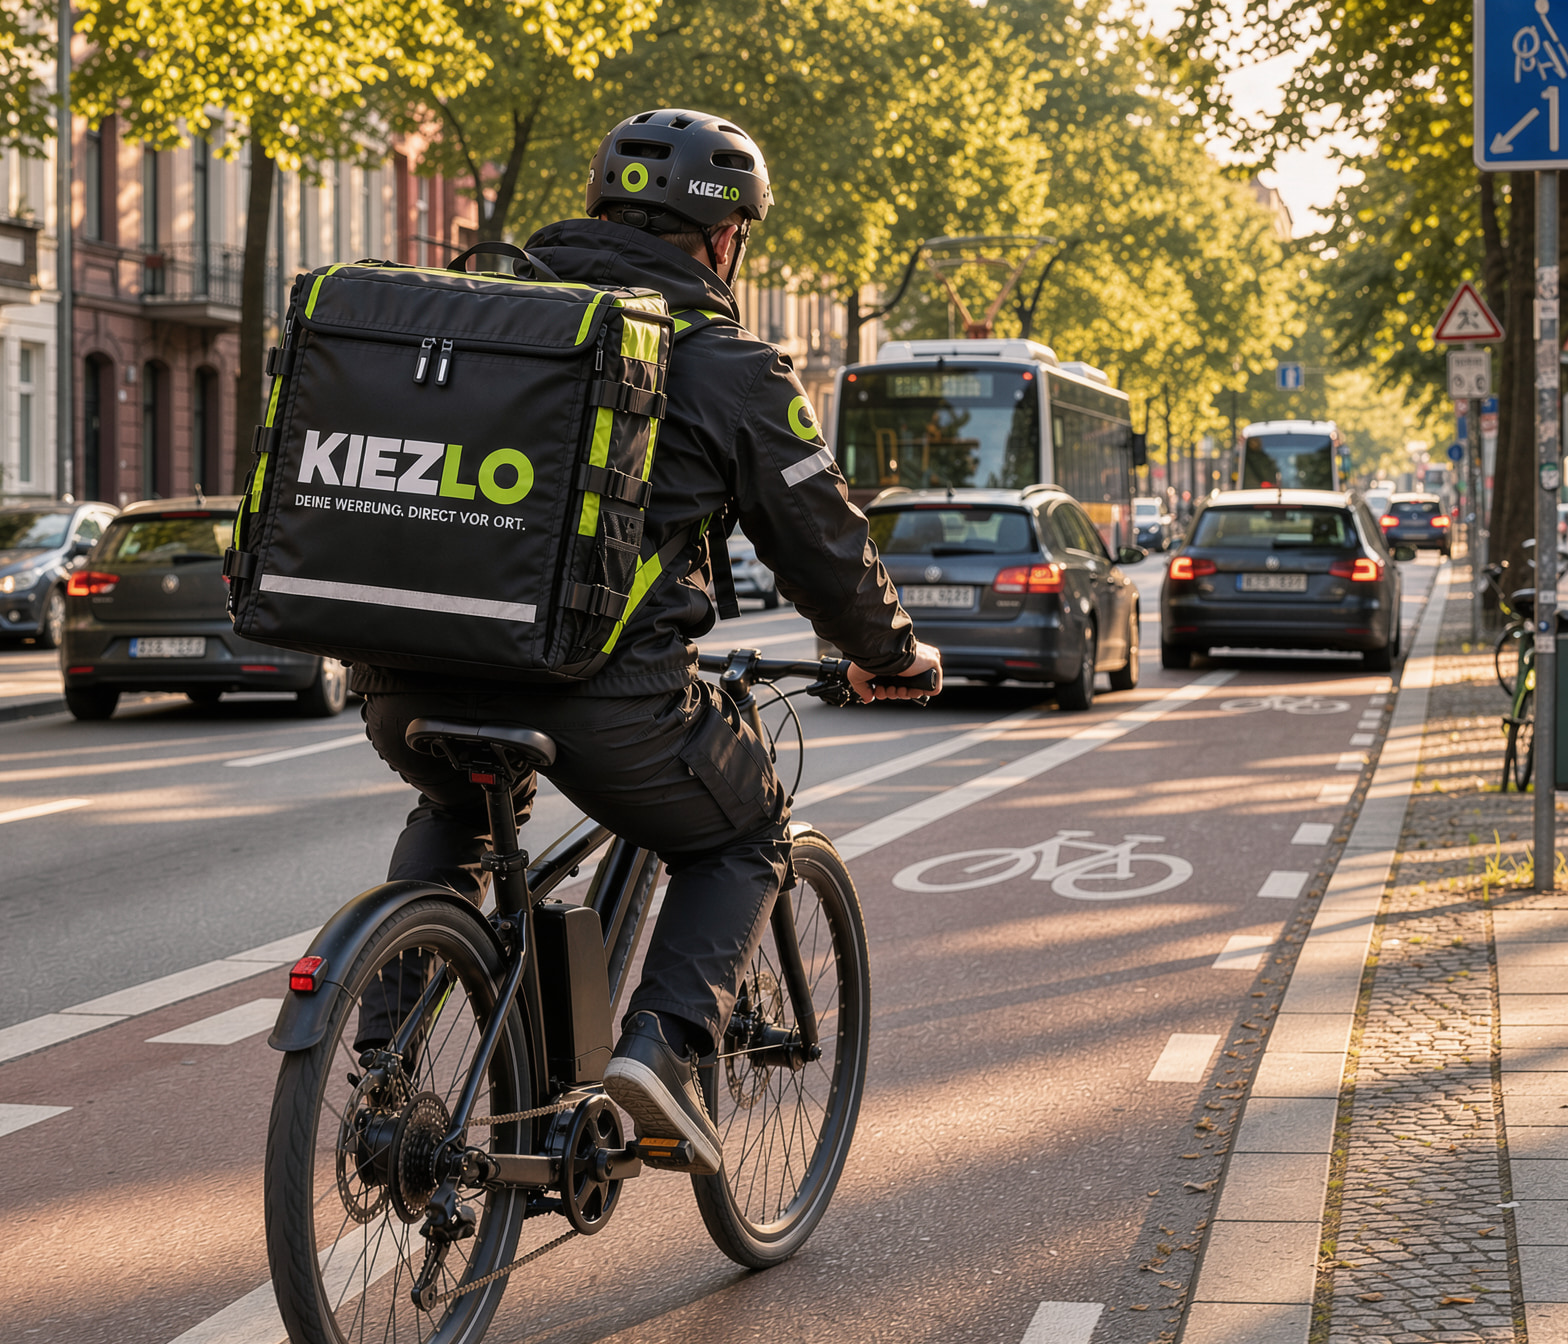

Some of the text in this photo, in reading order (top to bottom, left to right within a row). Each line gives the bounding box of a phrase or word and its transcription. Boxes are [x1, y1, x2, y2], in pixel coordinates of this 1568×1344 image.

[687, 179, 740, 202] KIEZLO
[297, 429, 534, 505] KIEZLO
[295, 494, 526, 531] DEINE WERBUNG. DIRECT VOR ORT.
